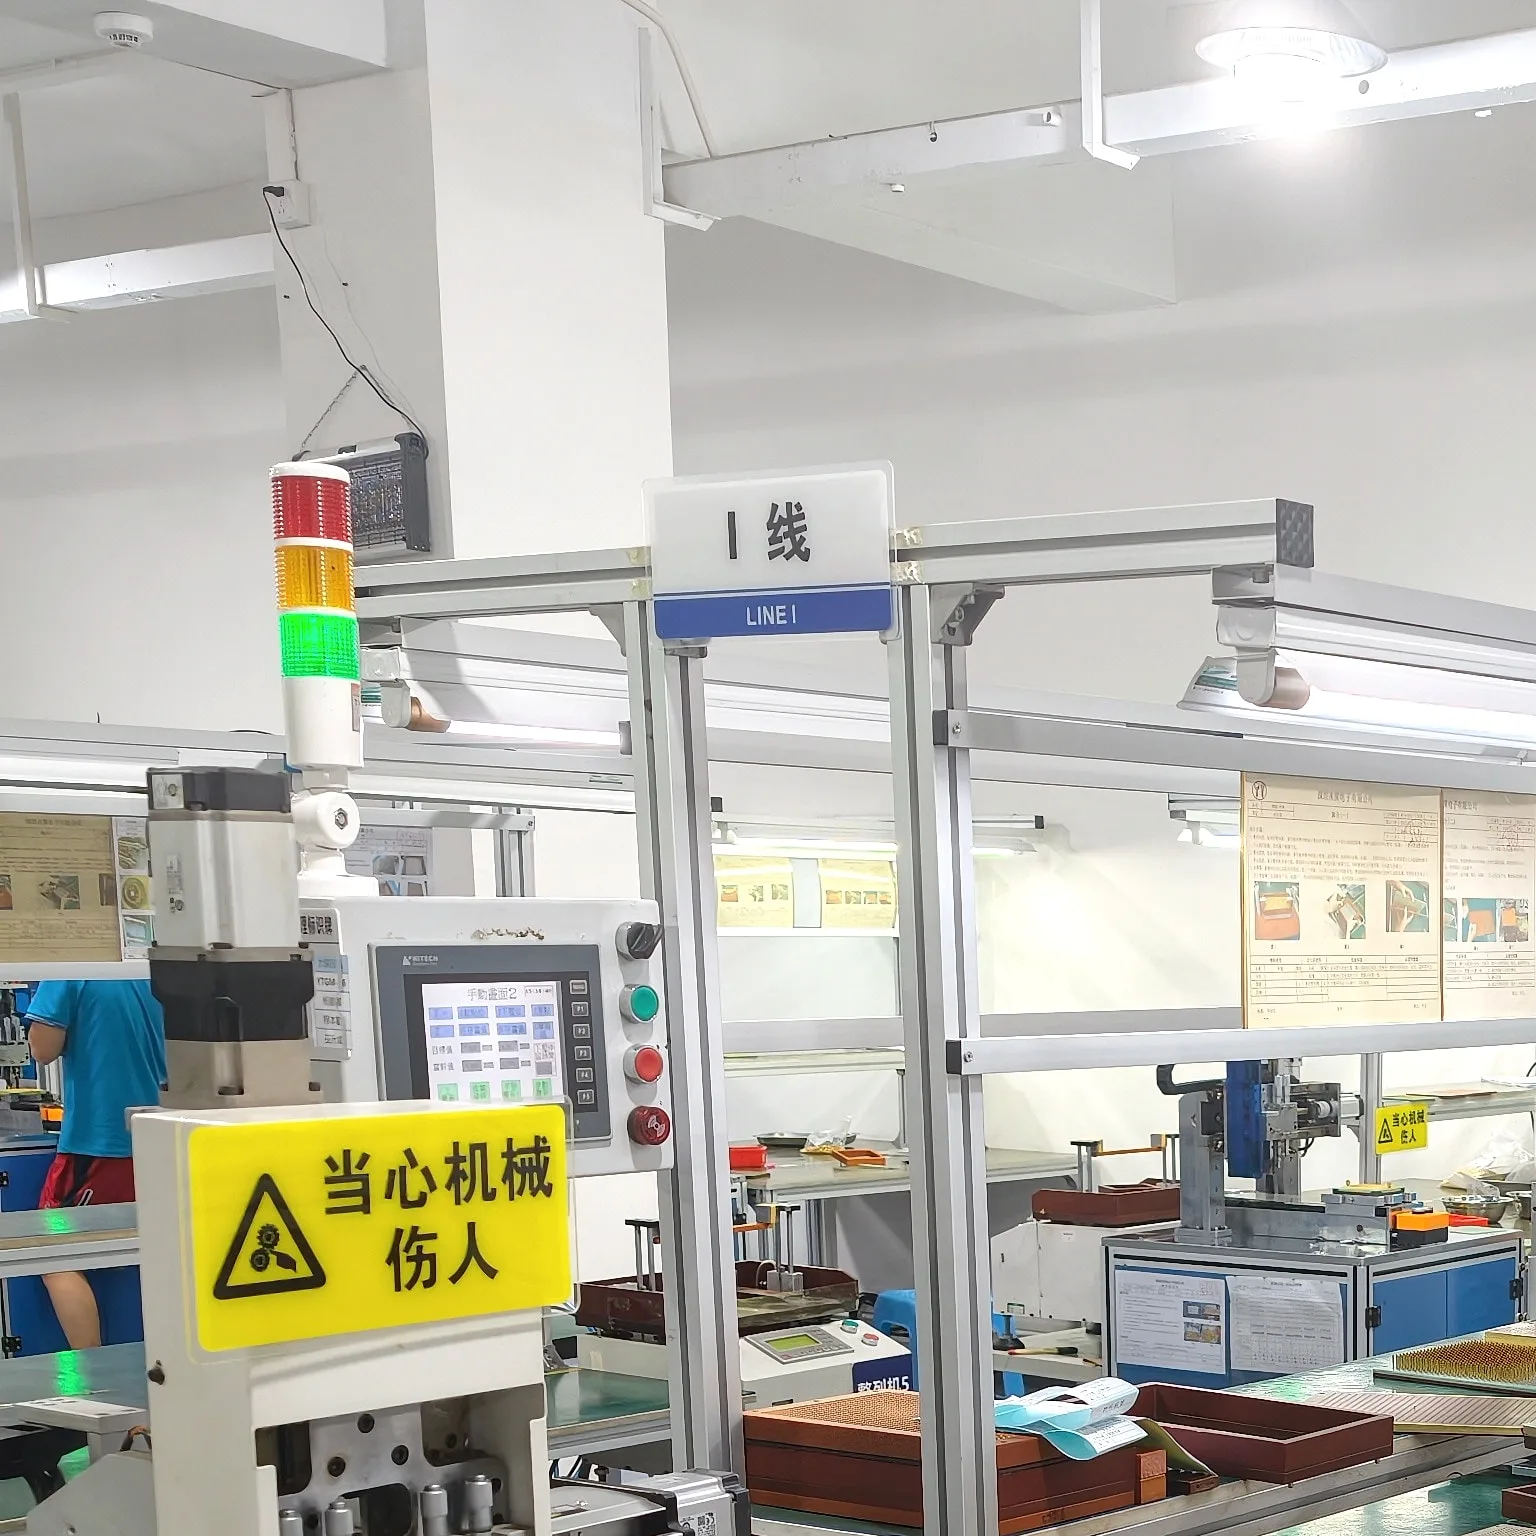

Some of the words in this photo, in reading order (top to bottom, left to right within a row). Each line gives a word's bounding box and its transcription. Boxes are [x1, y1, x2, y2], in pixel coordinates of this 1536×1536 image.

[766, 501, 811, 562] 线
[746, 605, 787, 626] LINE
[791, 604, 796, 624] I
[1392, 1110, 1425, 1127] 当心机械
[1401, 1129, 1416, 1144] 伤人
[324, 1135, 553, 1215] 当心机械
[386, 1222, 499, 1292] 伤人
